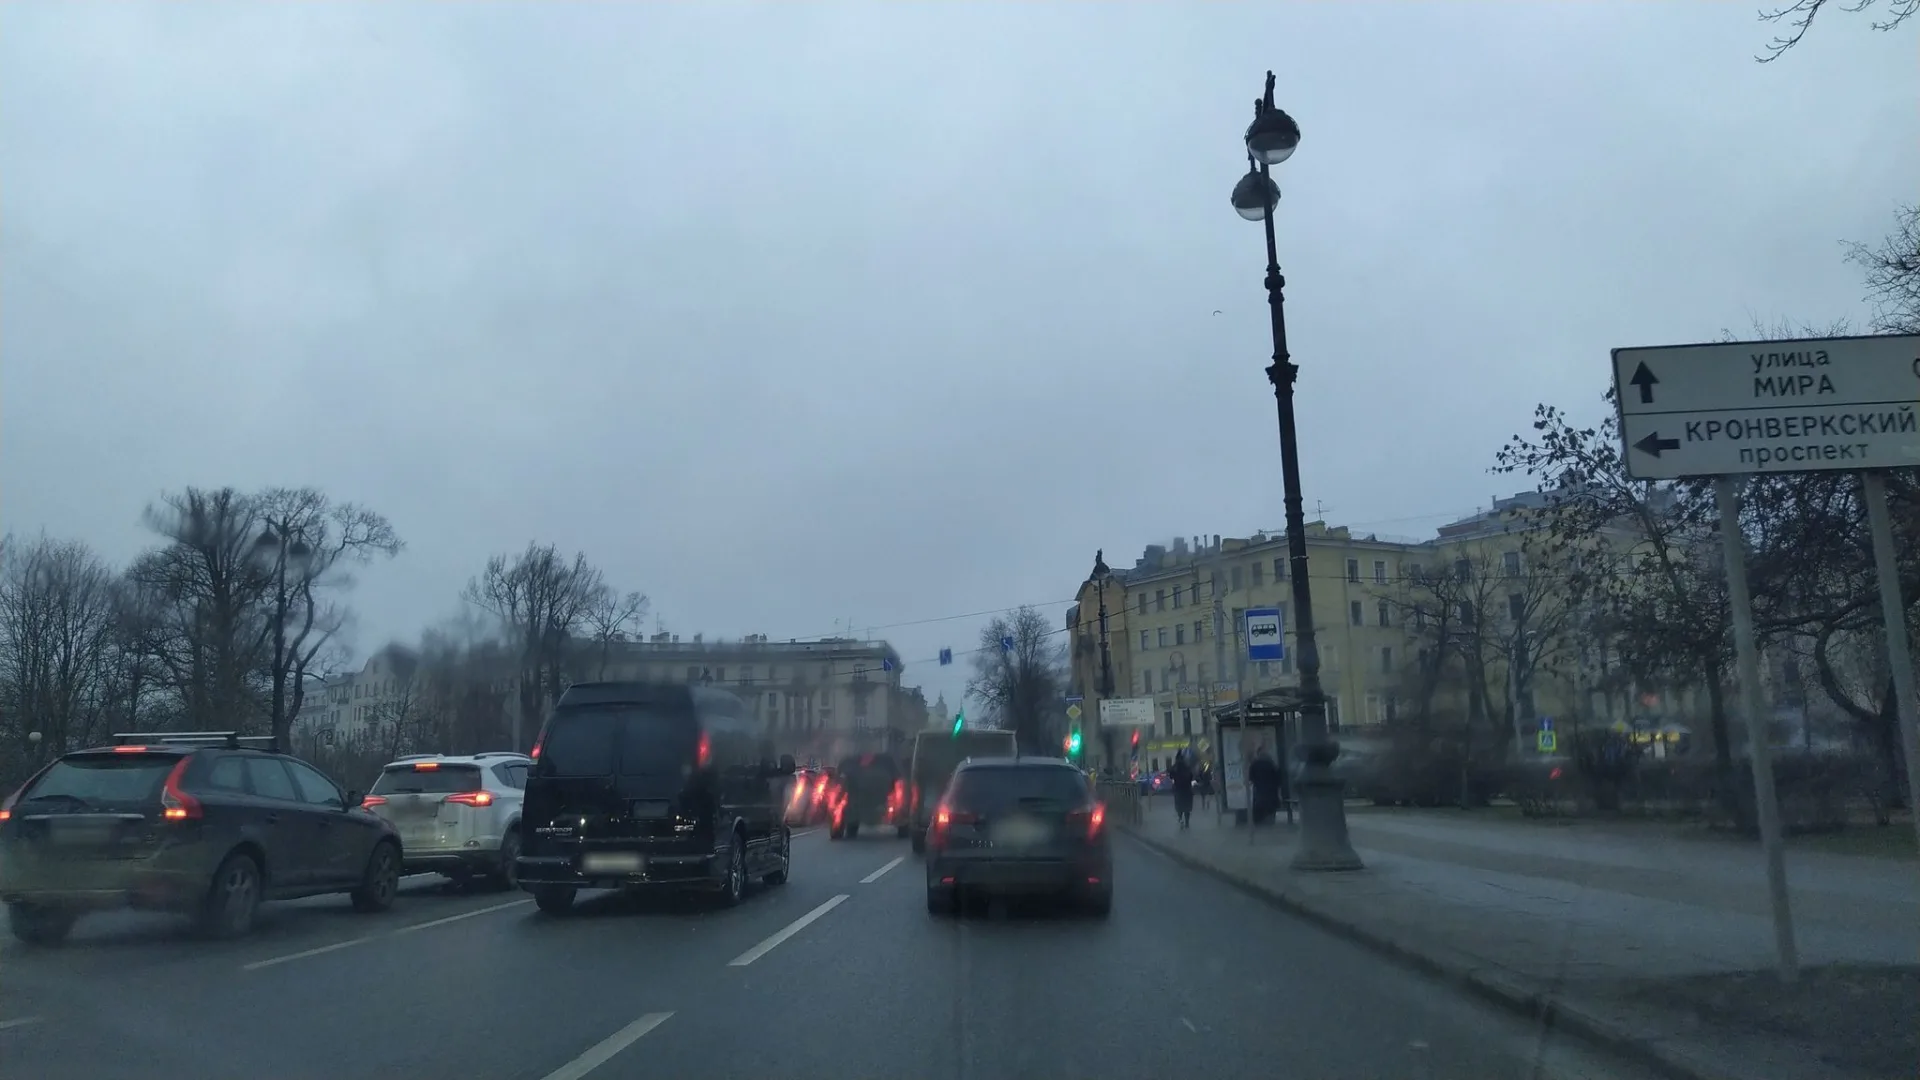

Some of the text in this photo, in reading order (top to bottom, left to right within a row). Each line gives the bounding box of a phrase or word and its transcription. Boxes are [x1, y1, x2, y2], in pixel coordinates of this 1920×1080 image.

[1751, 350, 1831, 374] улица
[1754, 374, 1836, 398] МИРА
[1685, 406, 1916, 441] КРОНВЕРКСКИЙ
[1739, 443, 1869, 468] проспект
